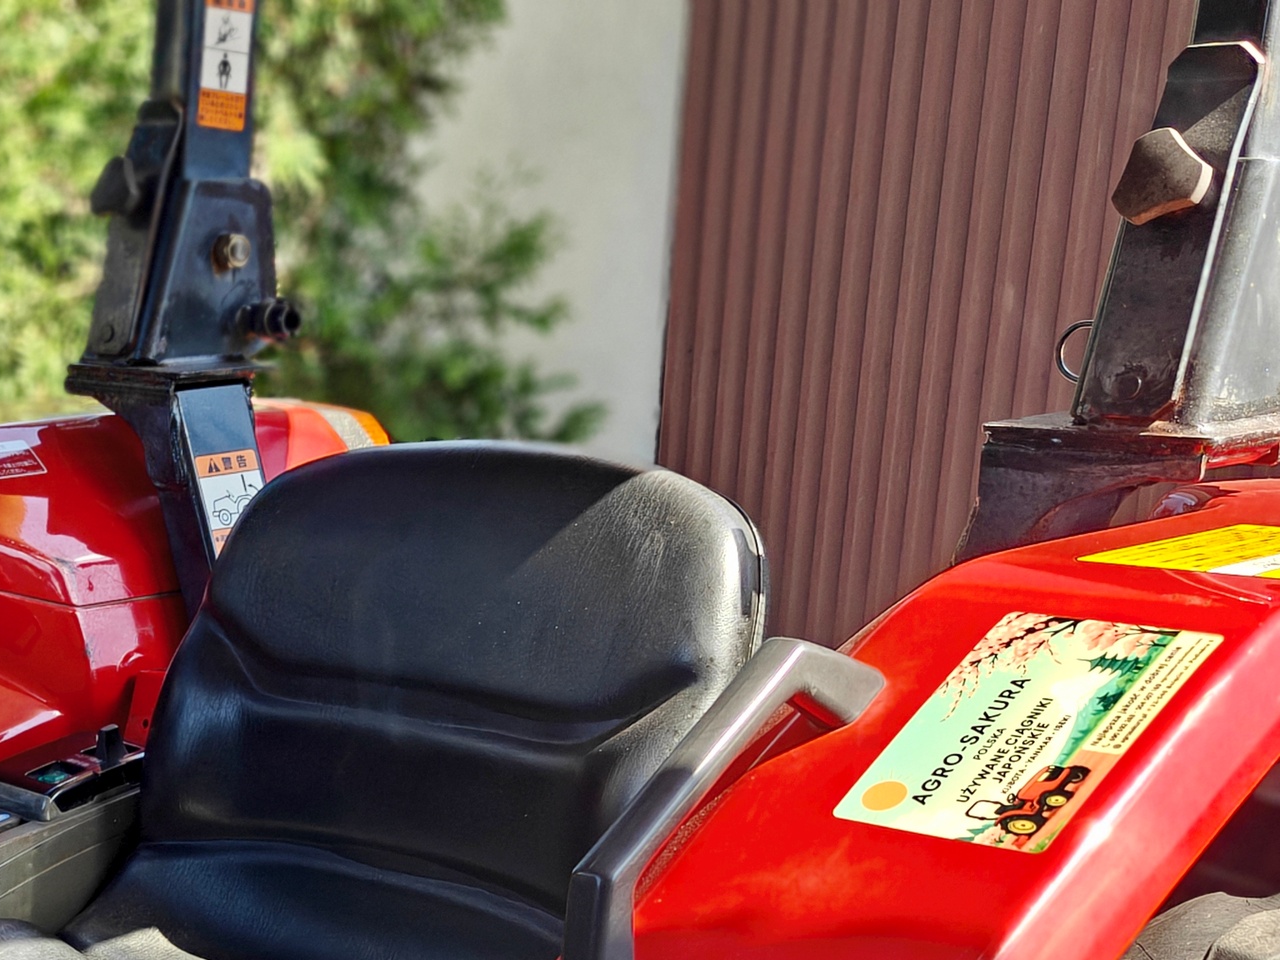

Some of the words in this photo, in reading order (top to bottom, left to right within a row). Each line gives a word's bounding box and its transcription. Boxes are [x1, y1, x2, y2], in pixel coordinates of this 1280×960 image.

[911, 678, 1032, 806] AGRO-SAKURA
[956, 748, 1010, 803] UŻYWANE
[1004, 697, 1054, 748] CIĄGNIKI
[972, 728, 1007, 761] POLSKA
[992, 722, 1050, 784] JAPOŃSKIE
